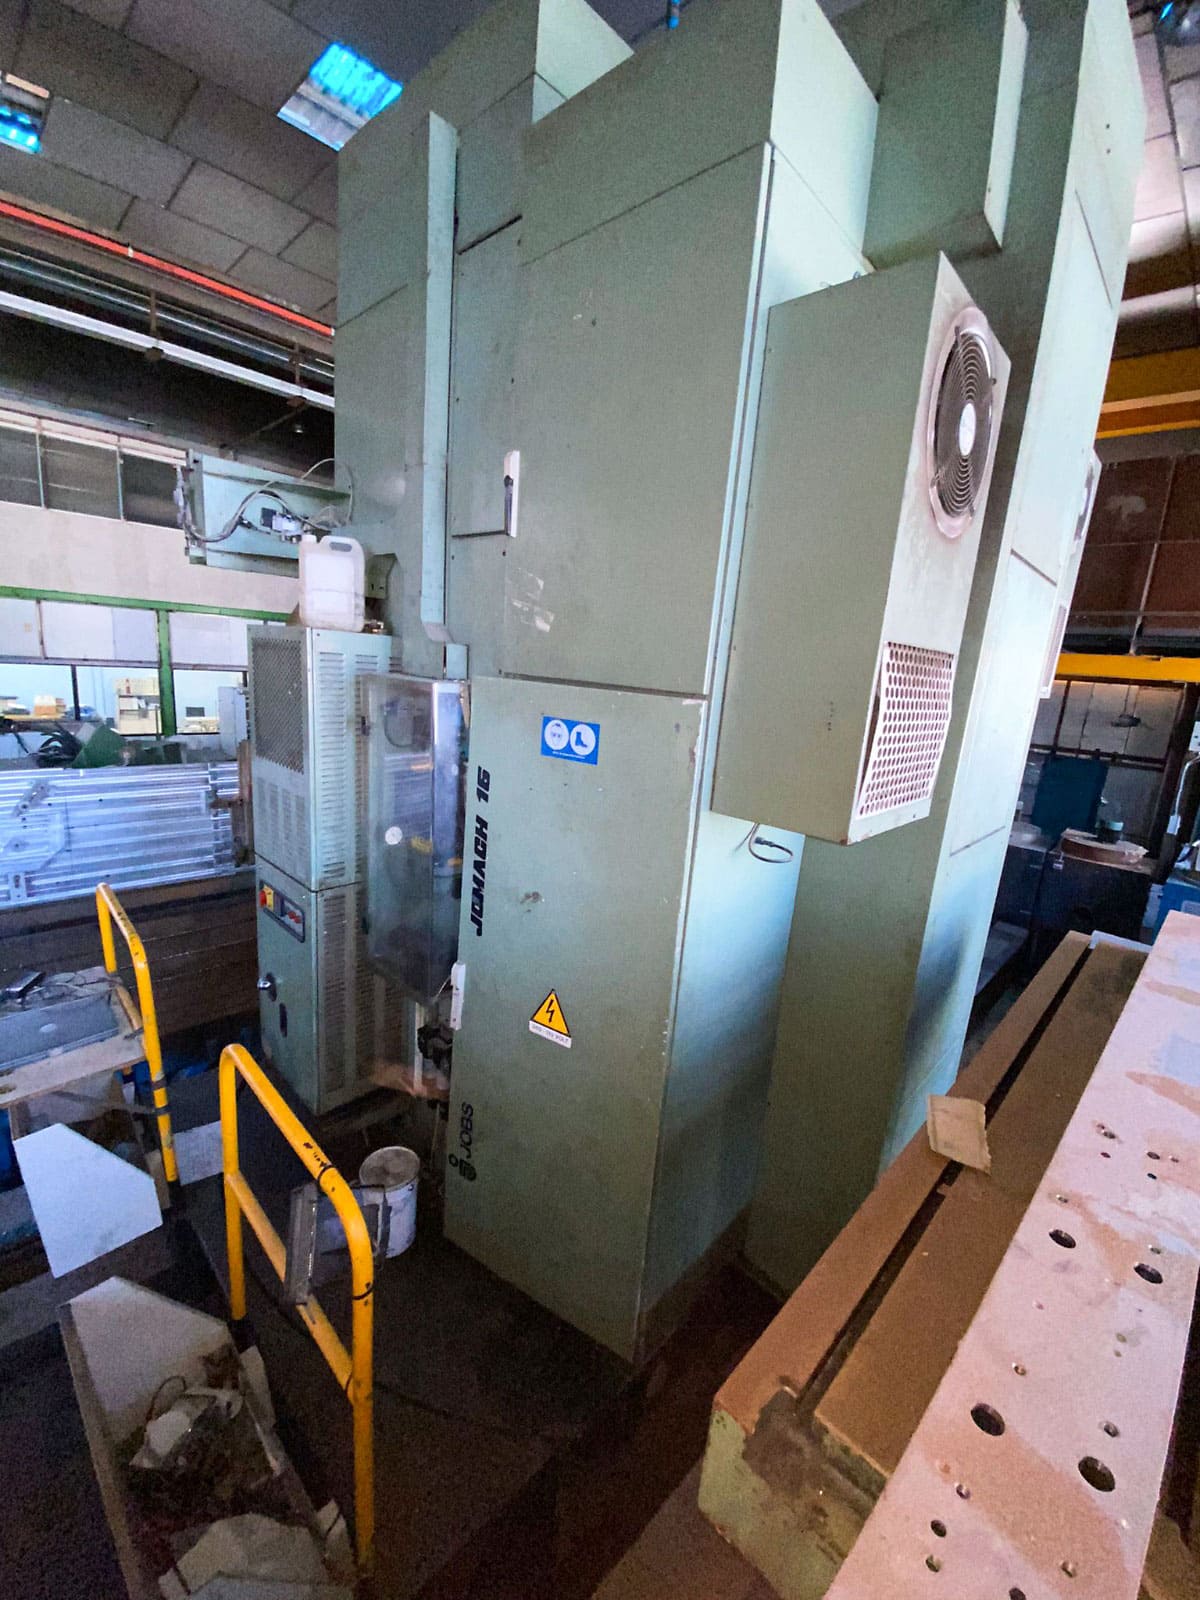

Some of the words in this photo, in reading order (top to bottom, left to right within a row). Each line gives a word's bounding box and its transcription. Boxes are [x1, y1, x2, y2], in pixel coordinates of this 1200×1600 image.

[476, 766, 490, 803] 16
[471, 815, 489, 936] JOMACH
[460, 1102, 473, 1158] JOBS
